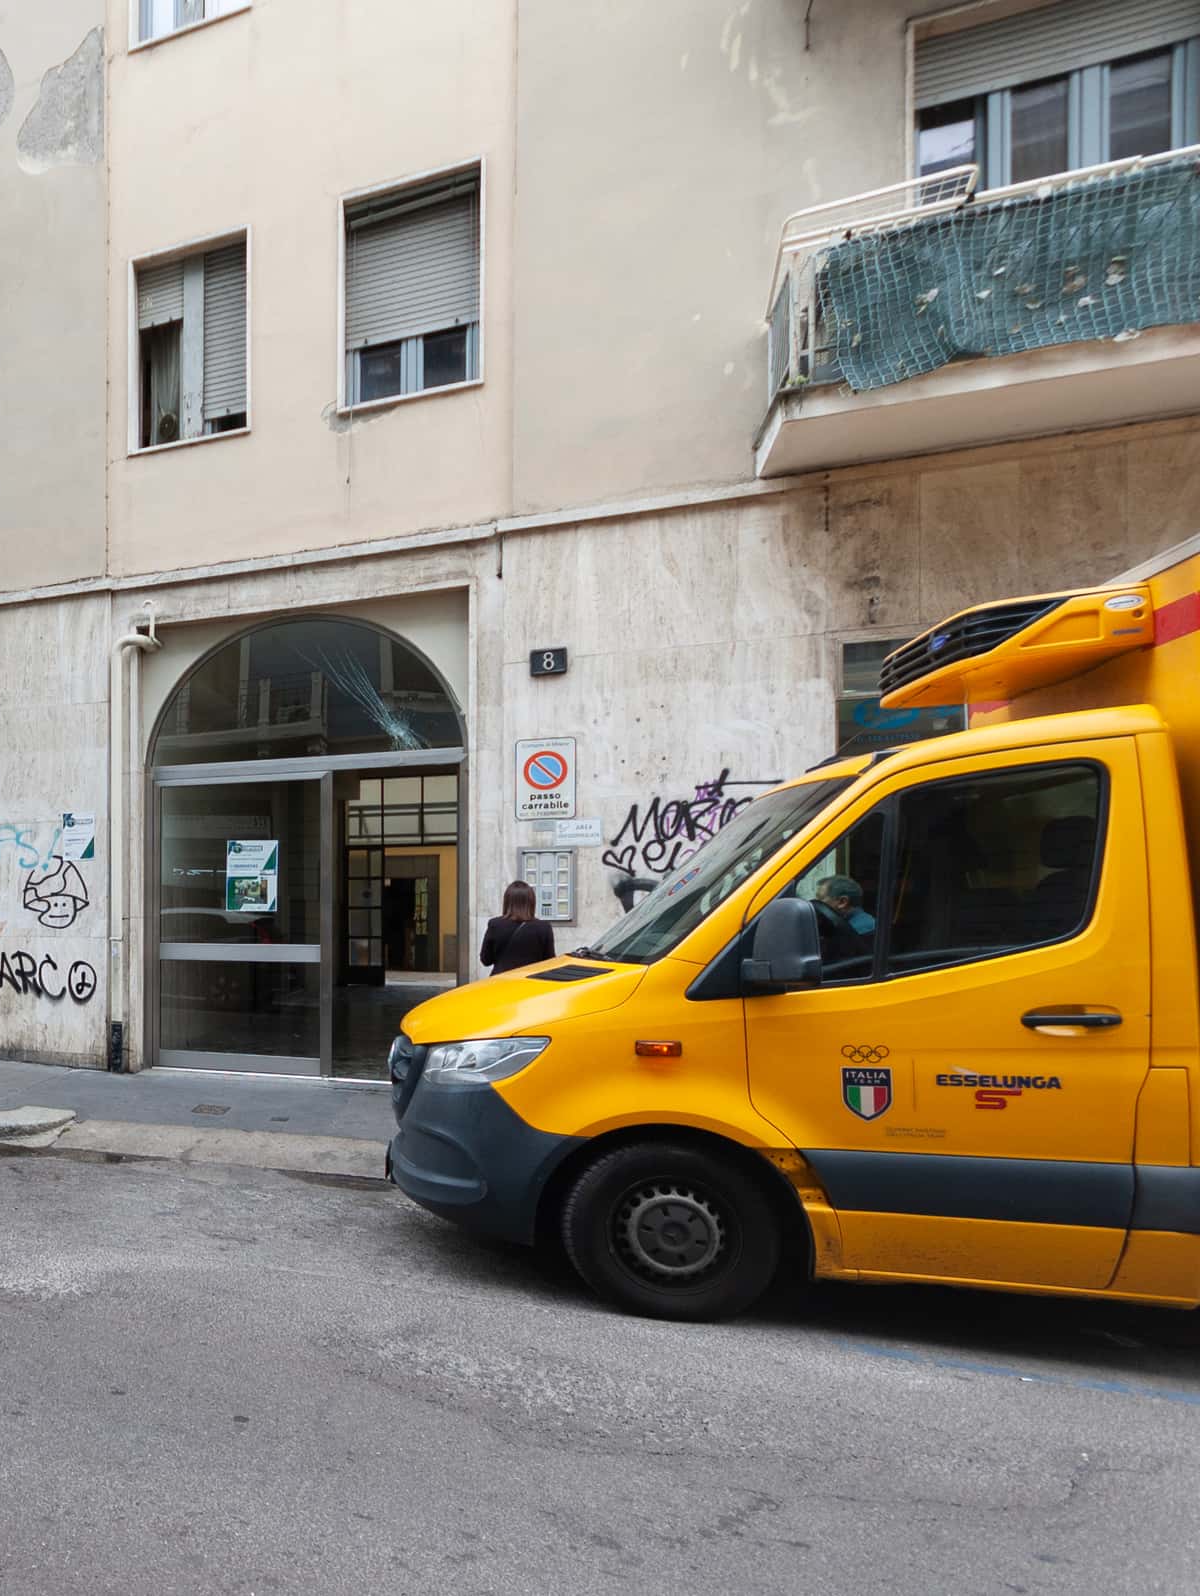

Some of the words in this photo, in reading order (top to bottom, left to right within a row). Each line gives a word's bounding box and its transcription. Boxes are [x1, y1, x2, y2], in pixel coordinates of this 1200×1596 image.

[543, 651, 554, 670] 8
[529, 793, 561, 801] passo
[521, 801, 569, 810] carrabile
[845, 1071, 887, 1080] ITALIA
[935, 1073, 1062, 1090] ESSELUNGA
